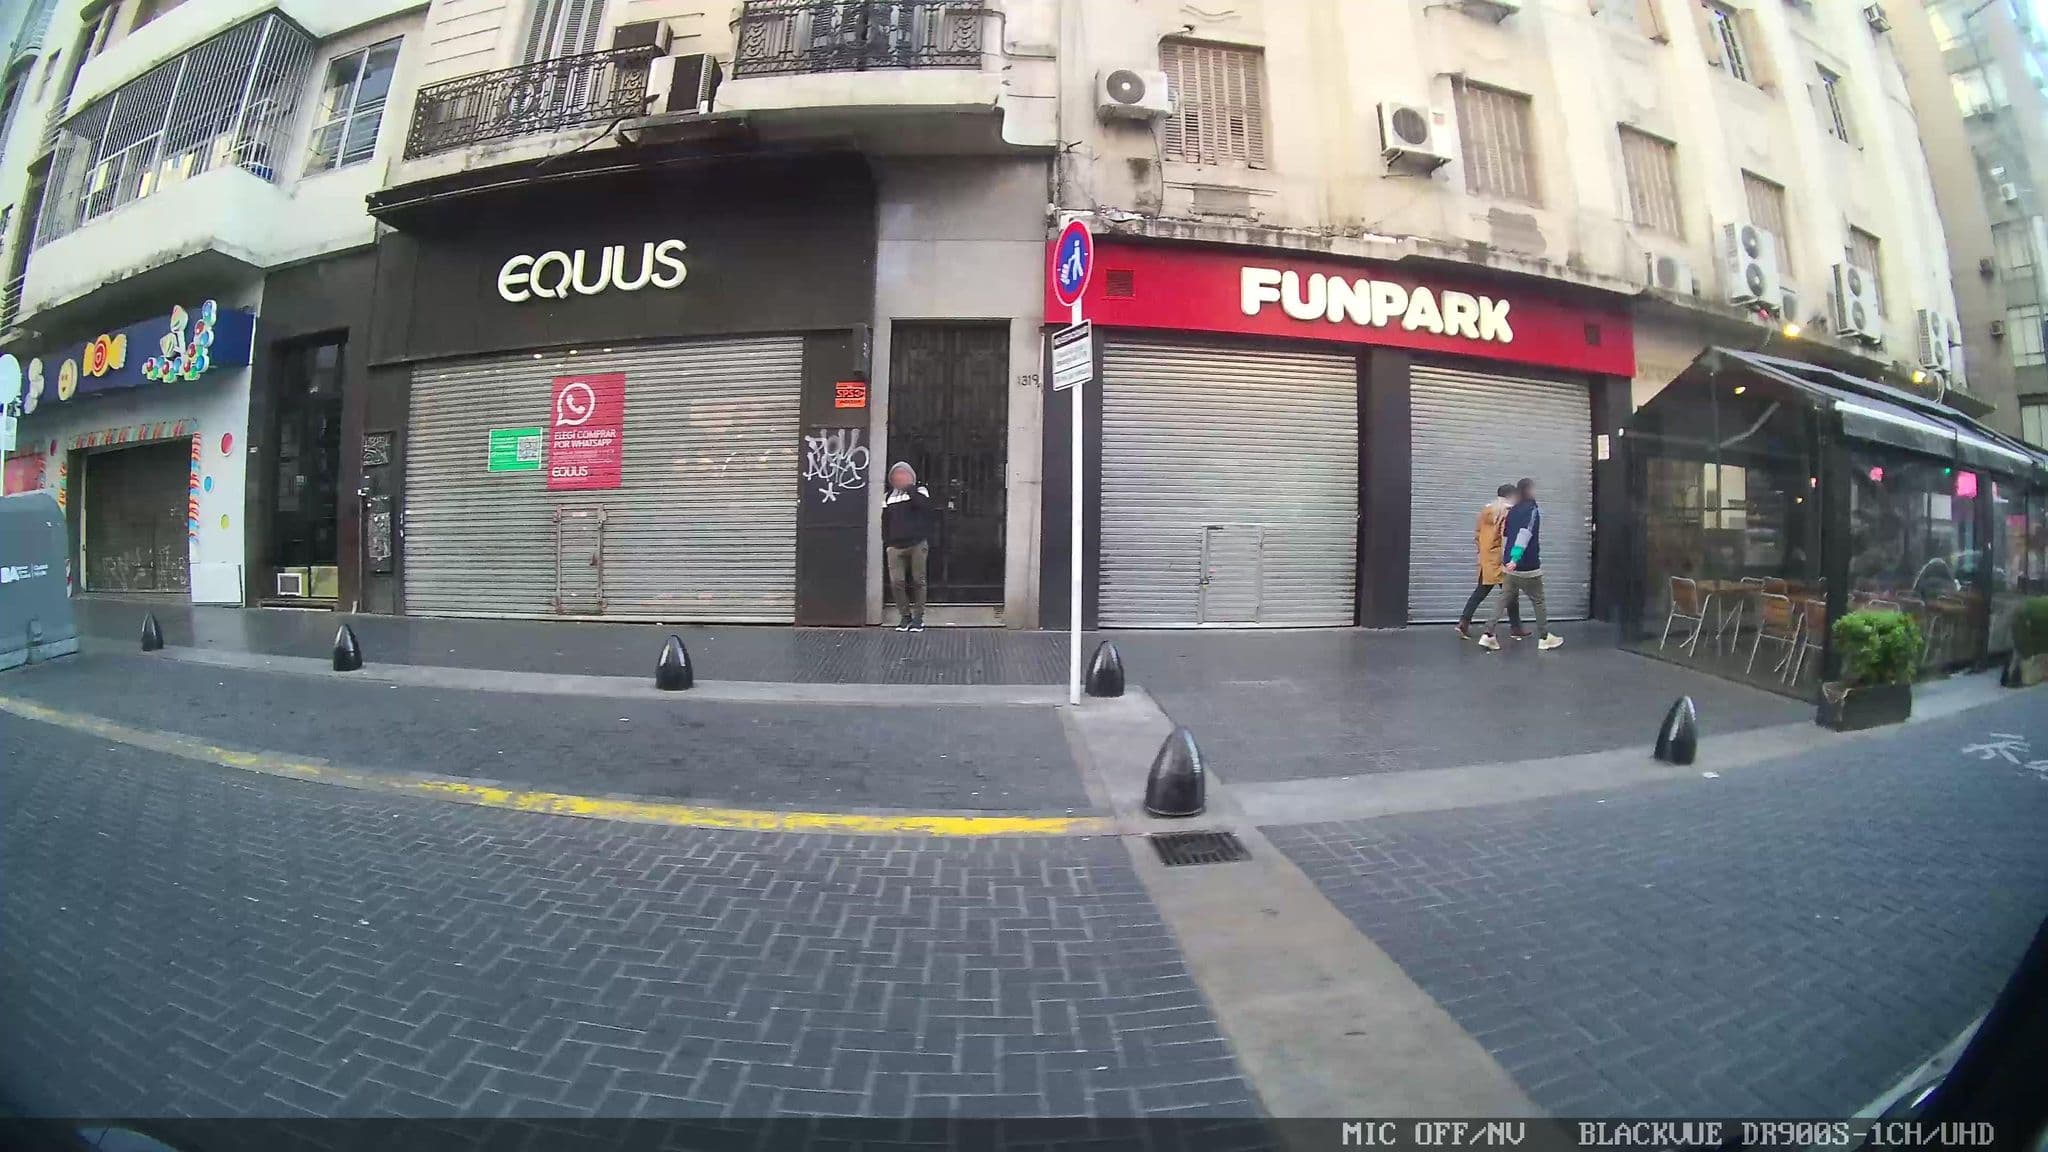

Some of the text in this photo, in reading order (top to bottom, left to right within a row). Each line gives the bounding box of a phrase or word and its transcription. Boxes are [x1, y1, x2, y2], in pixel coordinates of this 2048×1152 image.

[498, 239, 687, 302] EQUUS
[1240, 266, 1513, 343] FUNPARK
[578, 428, 616, 439] COMPRAR
[553, 440, 571, 449] POR
[551, 465, 588, 477] EQUUS
